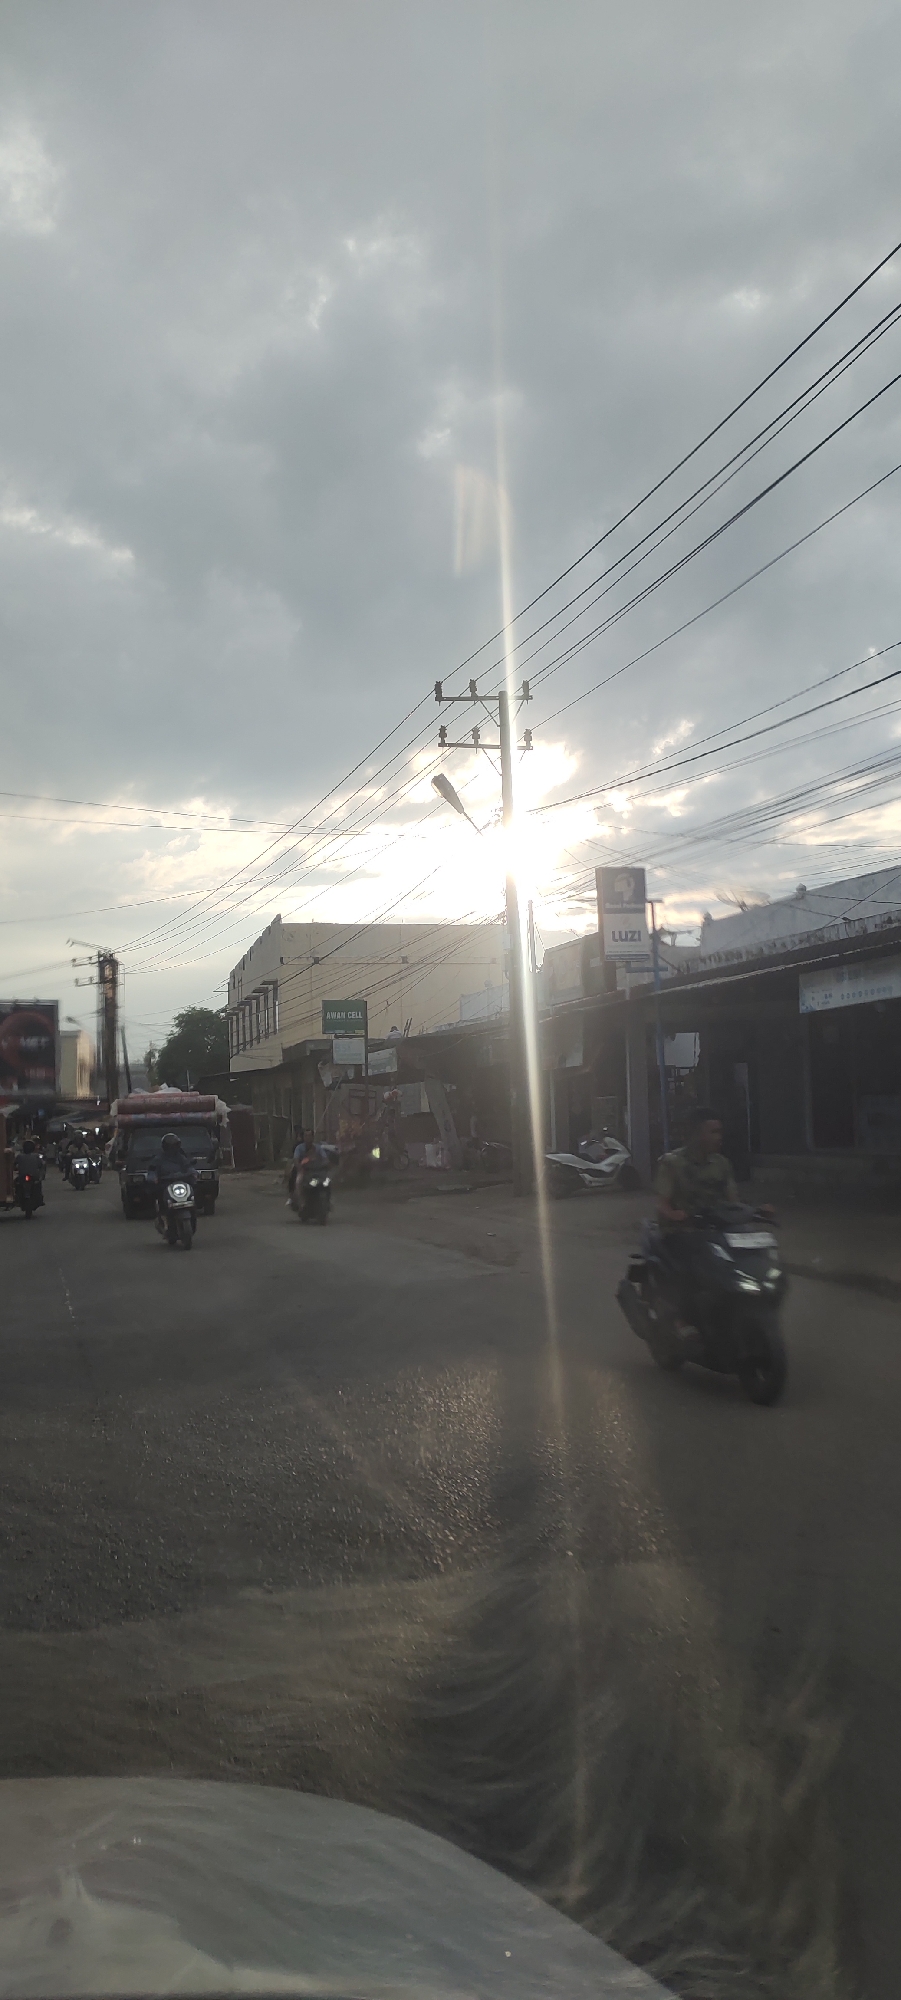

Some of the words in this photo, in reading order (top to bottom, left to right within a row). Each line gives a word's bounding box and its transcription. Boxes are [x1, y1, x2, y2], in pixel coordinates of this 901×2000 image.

[611, 930, 642, 942] LUZI
[326, 1011, 346, 1020] AWAN
[347, 1011, 363, 1019] CELL
